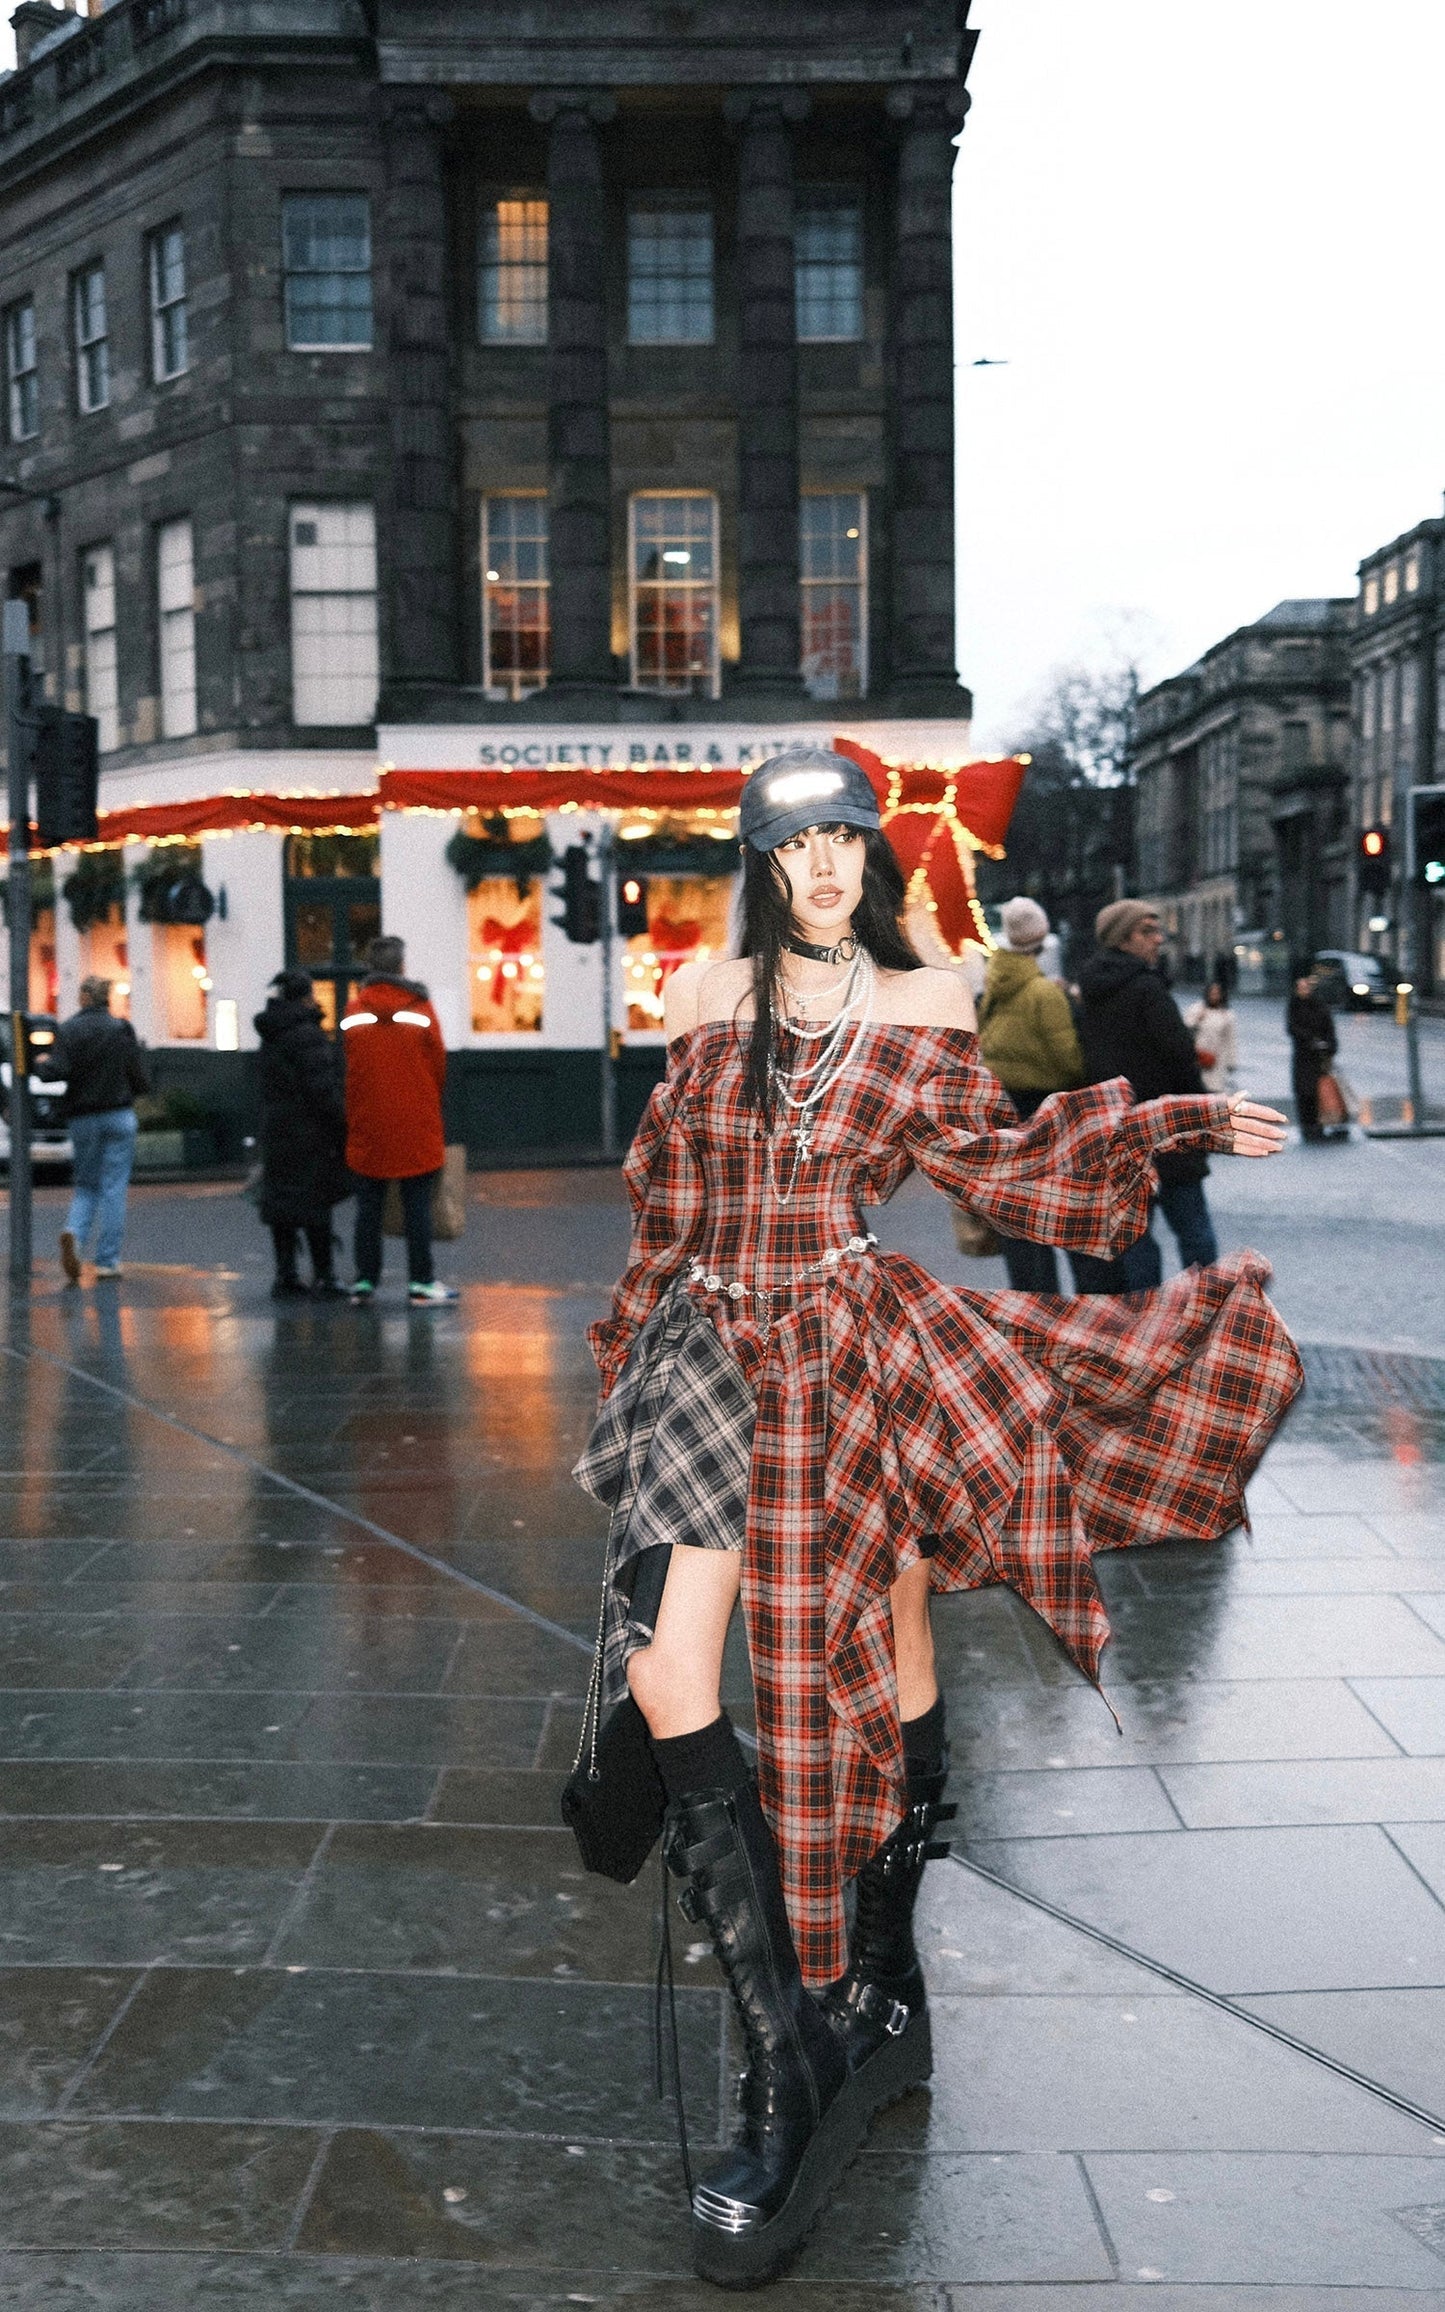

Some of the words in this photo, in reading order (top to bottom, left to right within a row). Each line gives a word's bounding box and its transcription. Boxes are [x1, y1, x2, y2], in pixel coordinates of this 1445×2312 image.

[479, 743, 613, 765] SOCIETY
[629, 743, 692, 763] BAR
[707, 742, 722, 763] &
